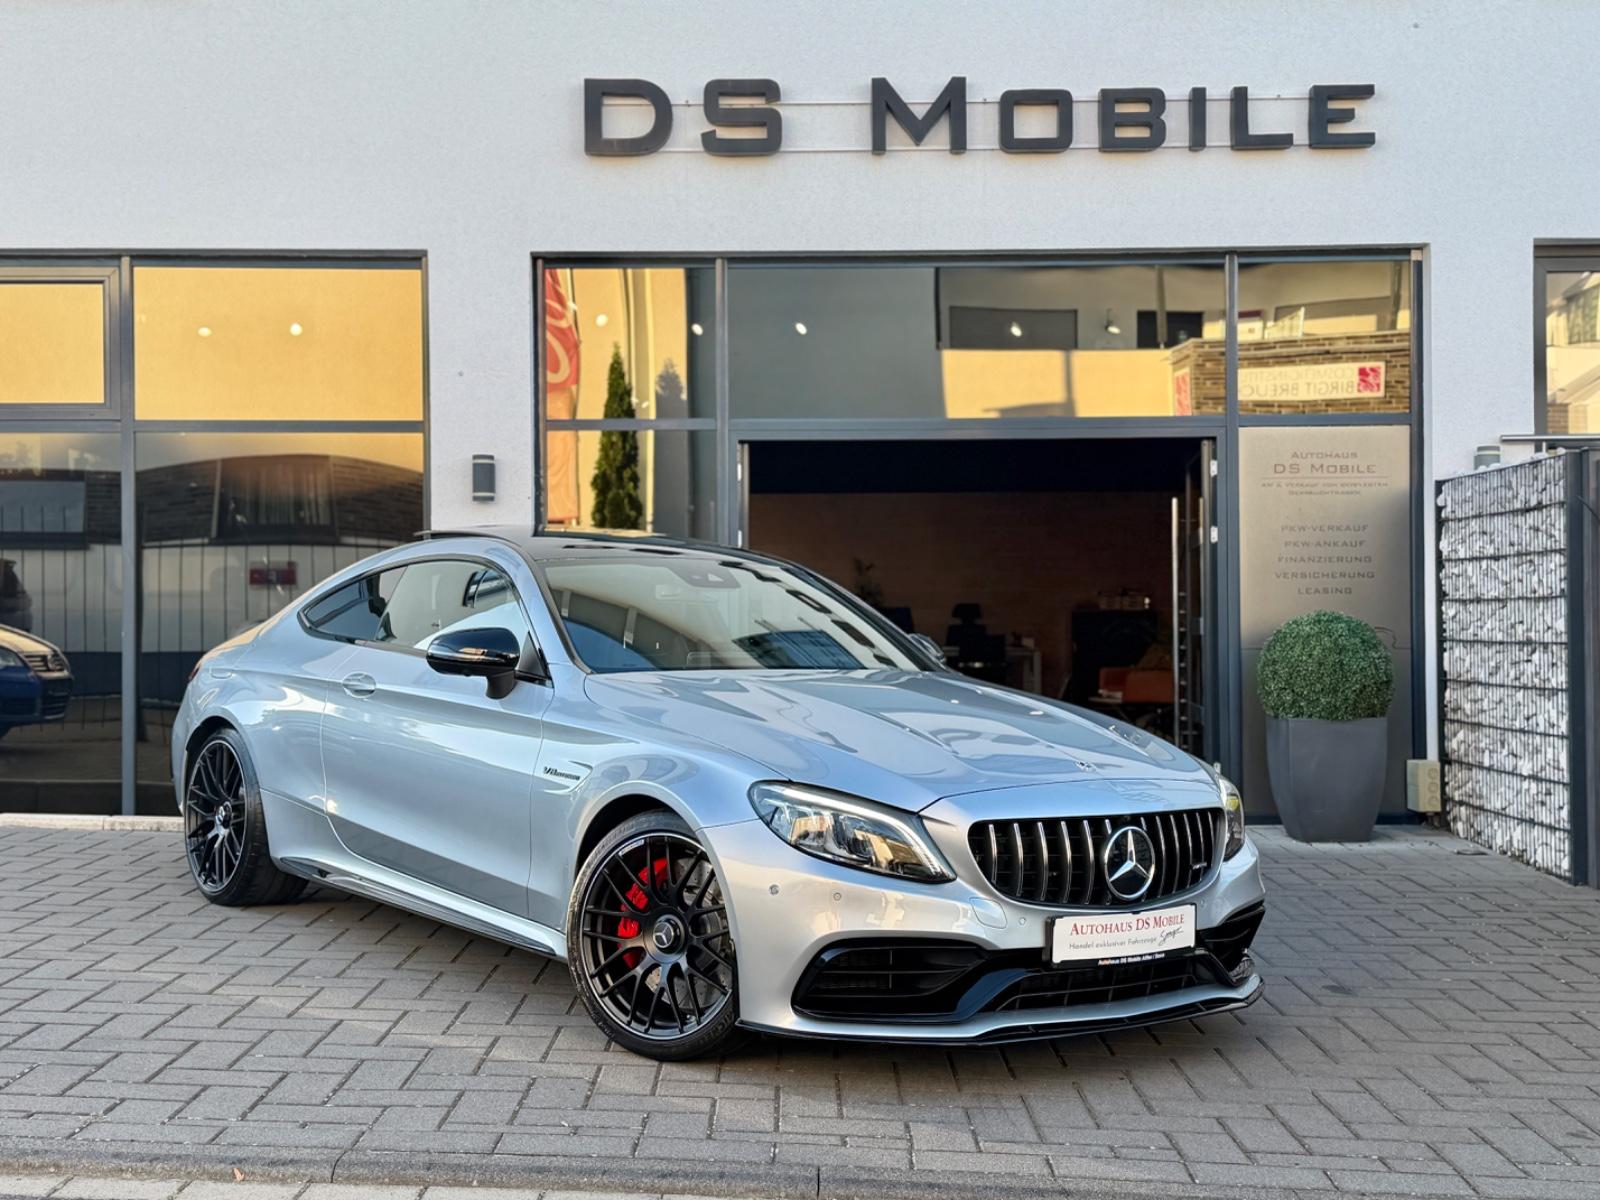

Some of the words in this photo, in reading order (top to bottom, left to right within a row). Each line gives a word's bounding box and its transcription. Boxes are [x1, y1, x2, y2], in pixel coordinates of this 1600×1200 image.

[584, 77, 783, 157] DS
[1273, 463, 1301, 475] DS
[1277, 555, 1373, 564] FINANZIERUNG
[1274, 571, 1376, 580] VERSICHERUNG
[1297, 587, 1353, 595] LEASING
[1135, 916, 1151, 931] DS
